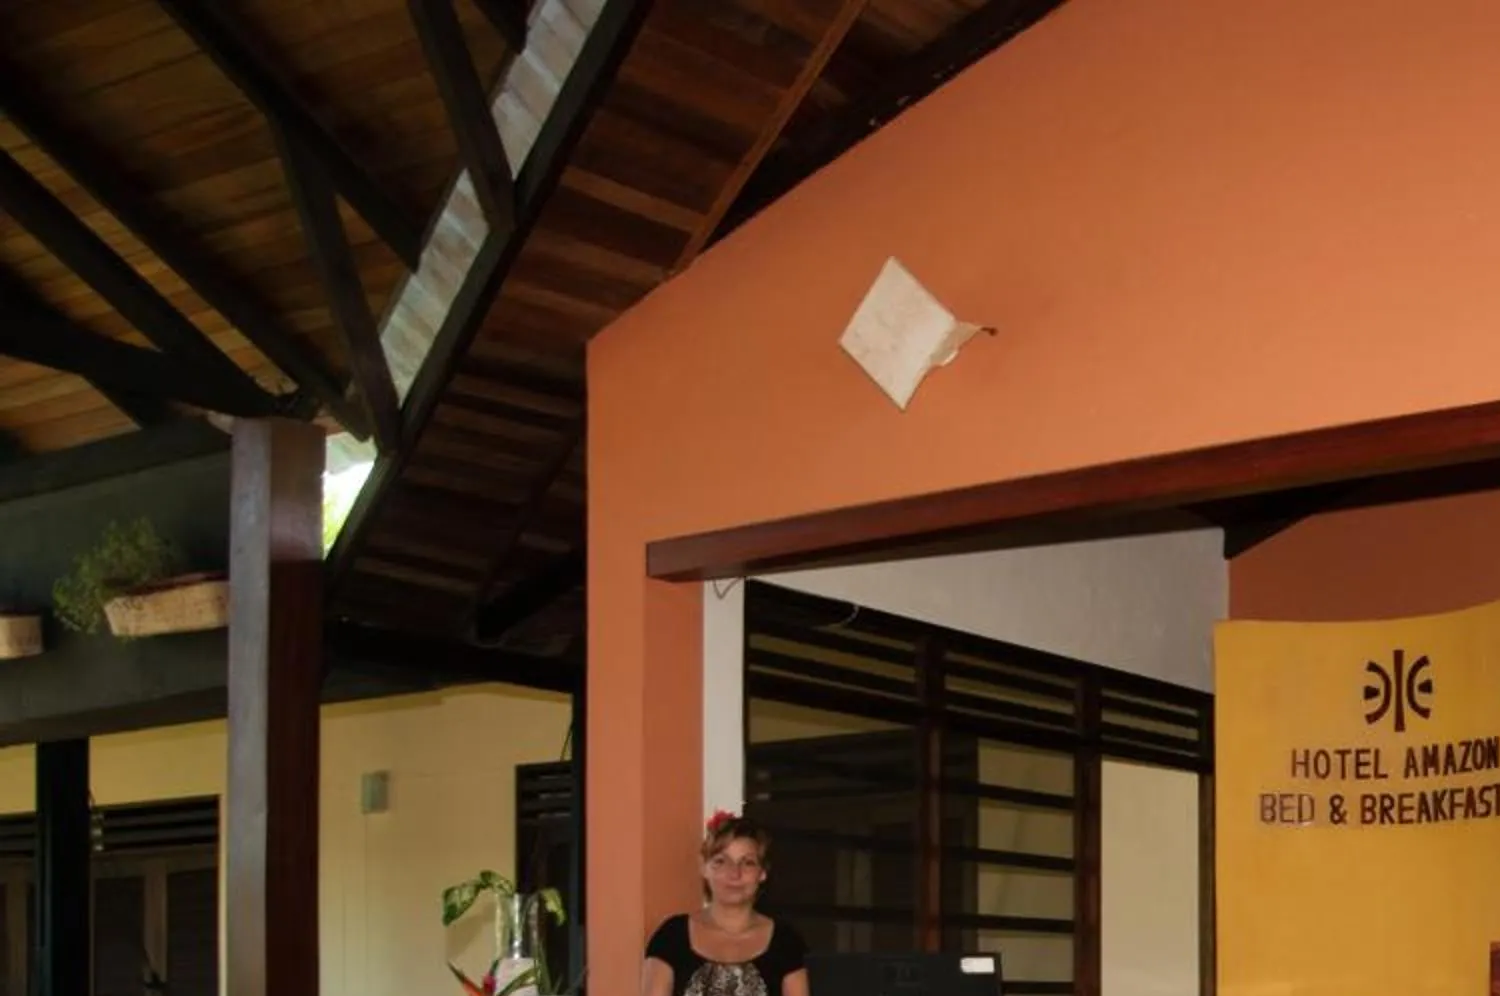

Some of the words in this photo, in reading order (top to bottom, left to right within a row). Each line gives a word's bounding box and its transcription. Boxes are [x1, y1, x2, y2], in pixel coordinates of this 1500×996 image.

[1291, 749, 1388, 780] HOTEL
[1403, 736, 1500, 779] AMAZON
[1260, 793, 1315, 824] BED
[1329, 793, 1348, 825] &
